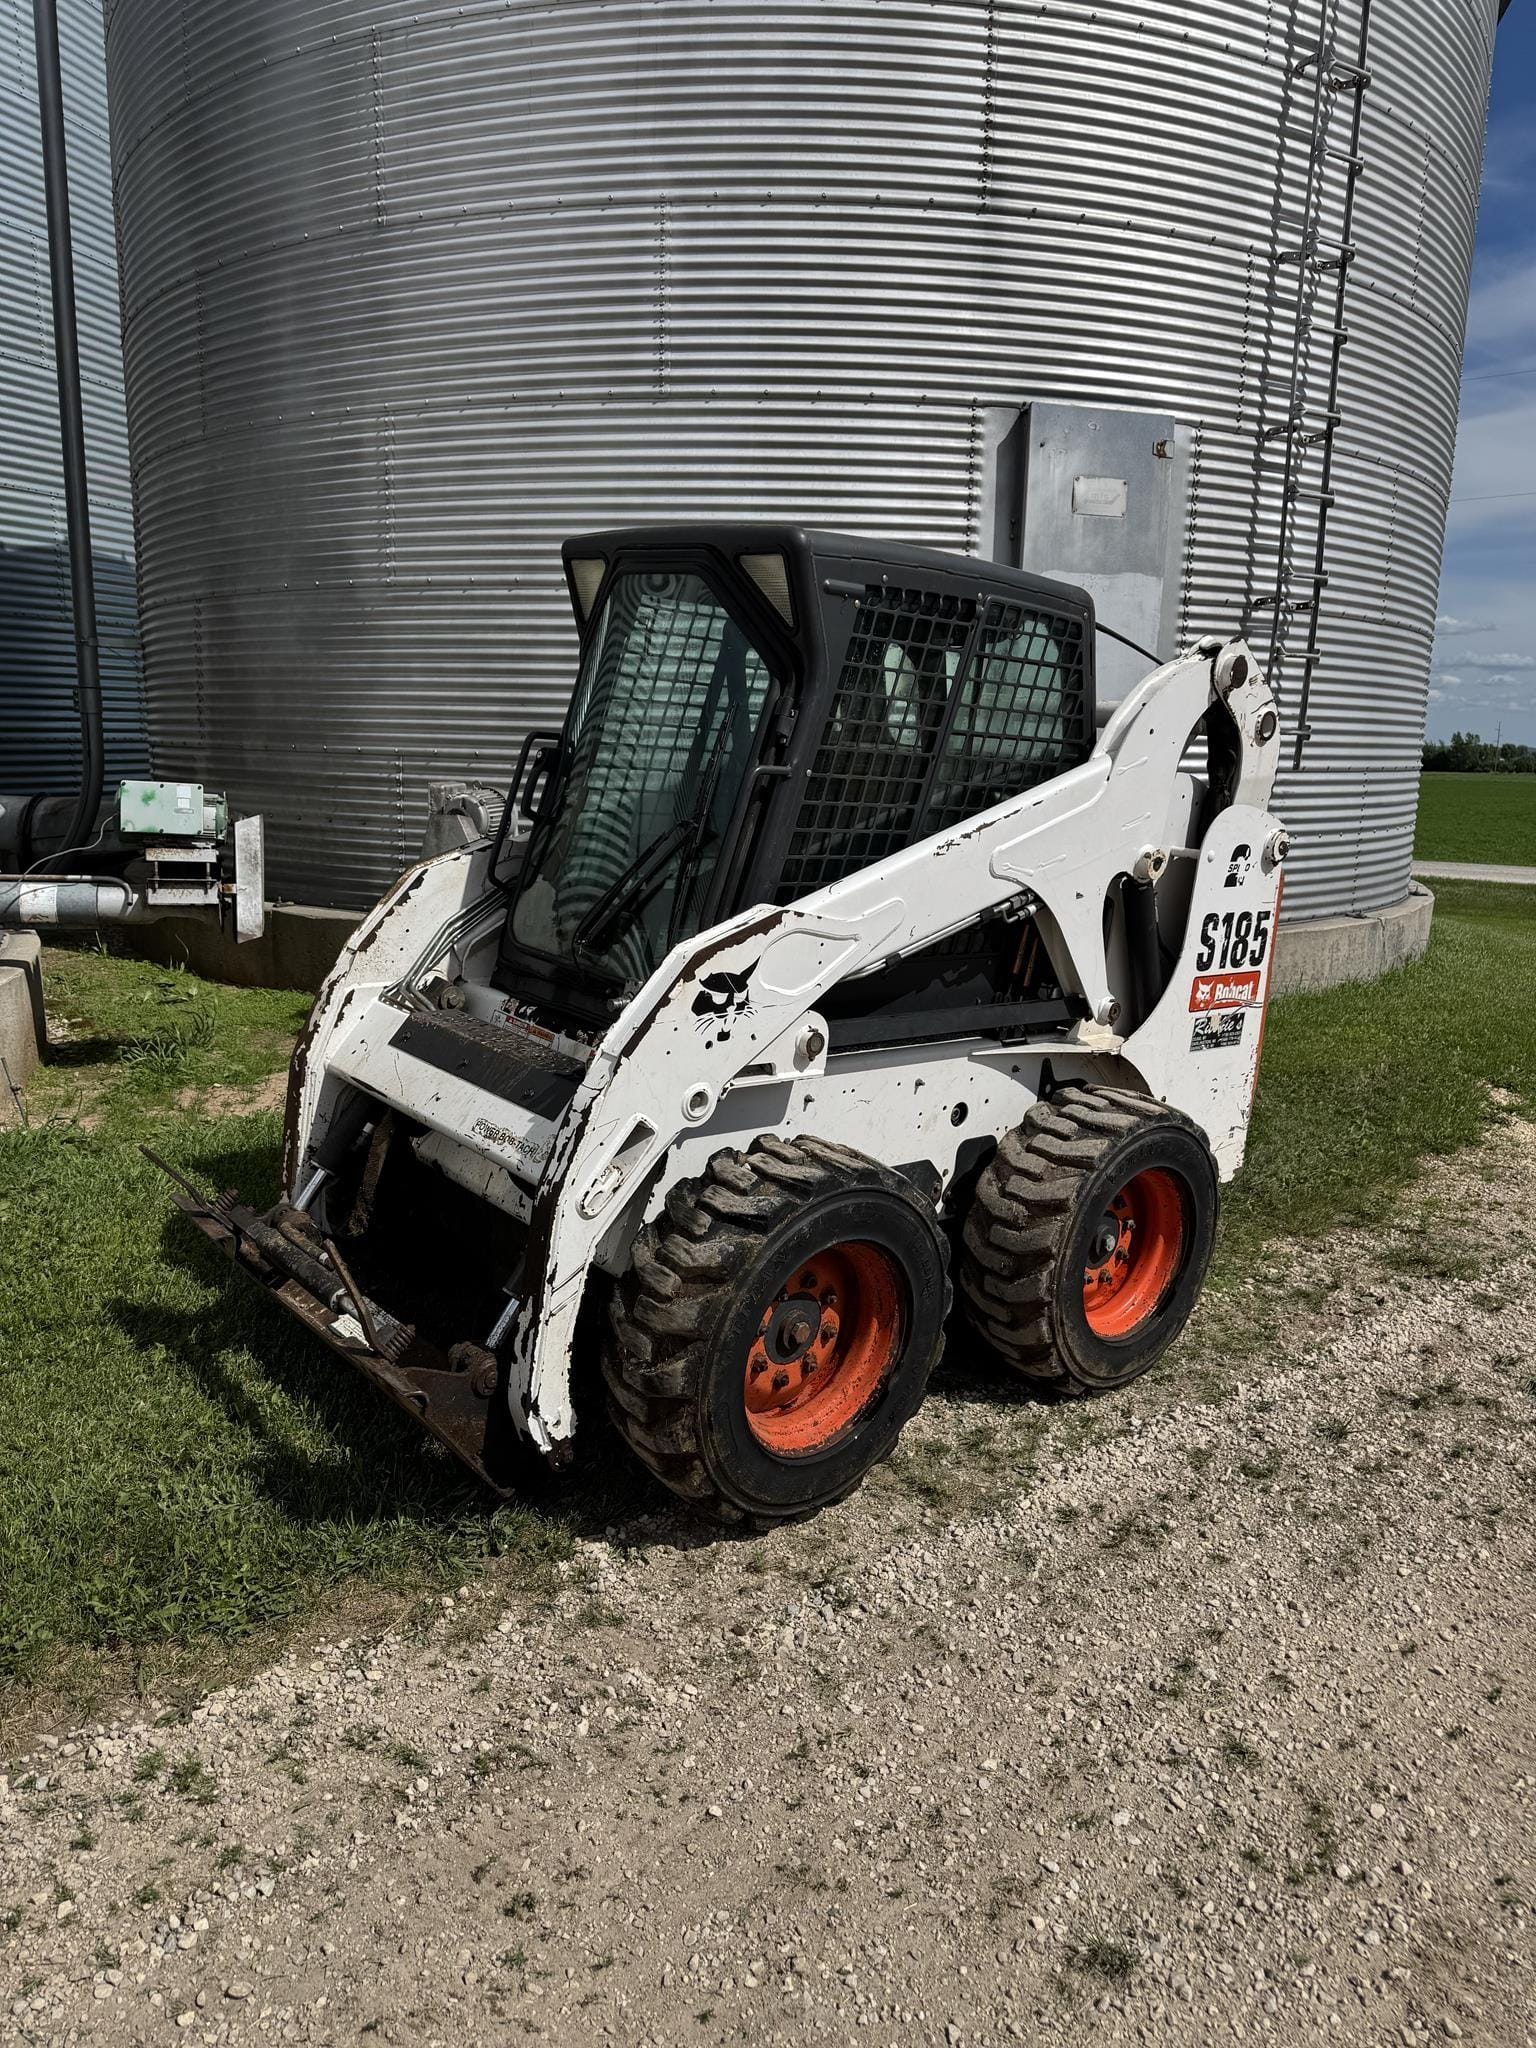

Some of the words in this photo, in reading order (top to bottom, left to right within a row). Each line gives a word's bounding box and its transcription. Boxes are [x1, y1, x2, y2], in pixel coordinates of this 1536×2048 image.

[1227, 863, 1251, 873] SPD
[1196, 911, 1271, 971] S185
[1215, 981, 1254, 1002] Bobcat
[475, 1120, 500, 1139] POWER
